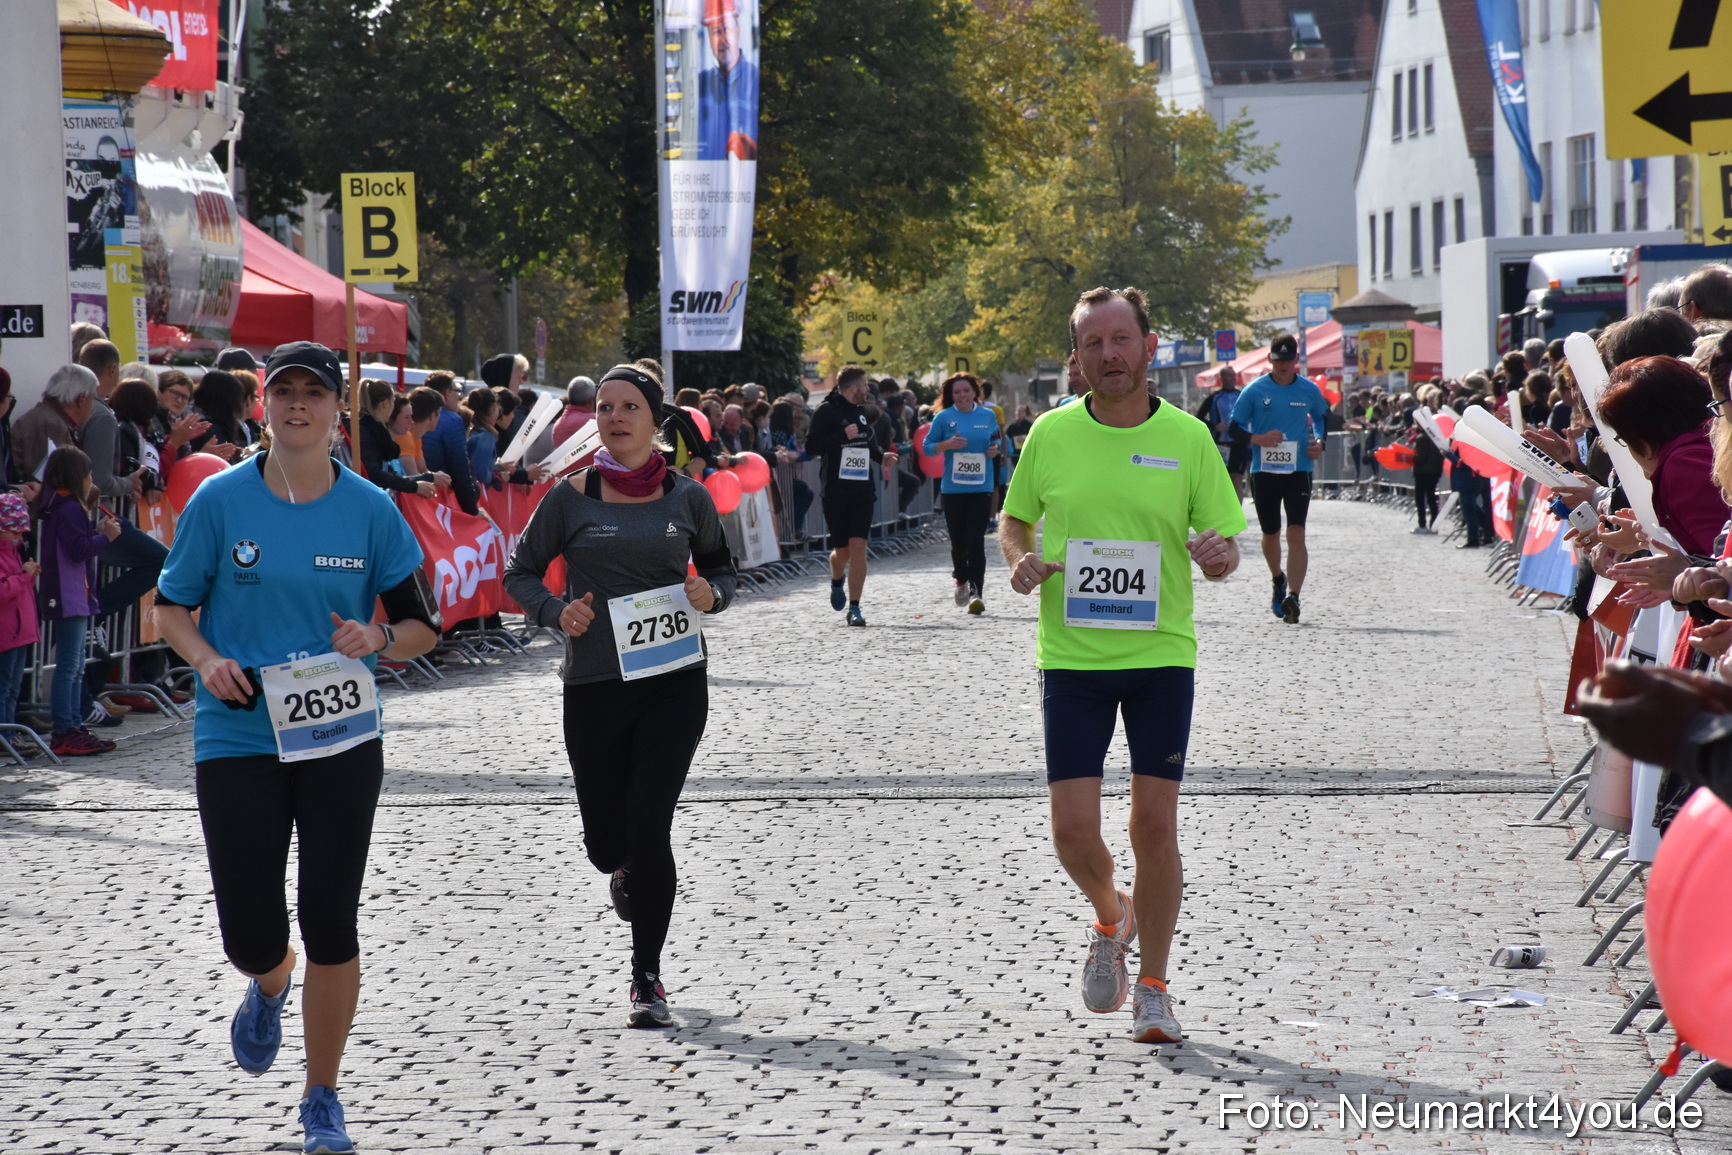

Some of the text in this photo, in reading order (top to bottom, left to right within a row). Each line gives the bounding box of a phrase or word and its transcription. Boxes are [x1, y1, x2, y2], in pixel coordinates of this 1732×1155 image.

[85, 173, 100, 186] CUP
[673, 172, 691, 186] FÜR
[350, 177, 407, 197] Block
[672, 208, 696, 220] GEBE
[362, 206, 399, 259] B
[109, 263, 131, 284] 18.
[847, 312, 878, 322] Block
[852, 327, 873, 356] C
[1388, 330, 1412, 339] Block
[1393, 342, 1407, 363] D
[845, 457, 866, 468] 2909
[1266, 451, 1292, 462] 2333
[957, 462, 981, 473] 2908
[1102, 548, 1134, 557] BOCK
[314, 555, 365, 569] BOCK
[234, 572, 261, 580] PARTL
[1078, 566, 1146, 595] 2304
[643, 594, 672, 607] BOCK
[1089, 602, 1133, 615] Bernhard
[627, 610, 689, 646] 2736
[303, 662, 340, 678] BOCK
[284, 679, 361, 723] 2633
[312, 724, 348, 741] Carolin
